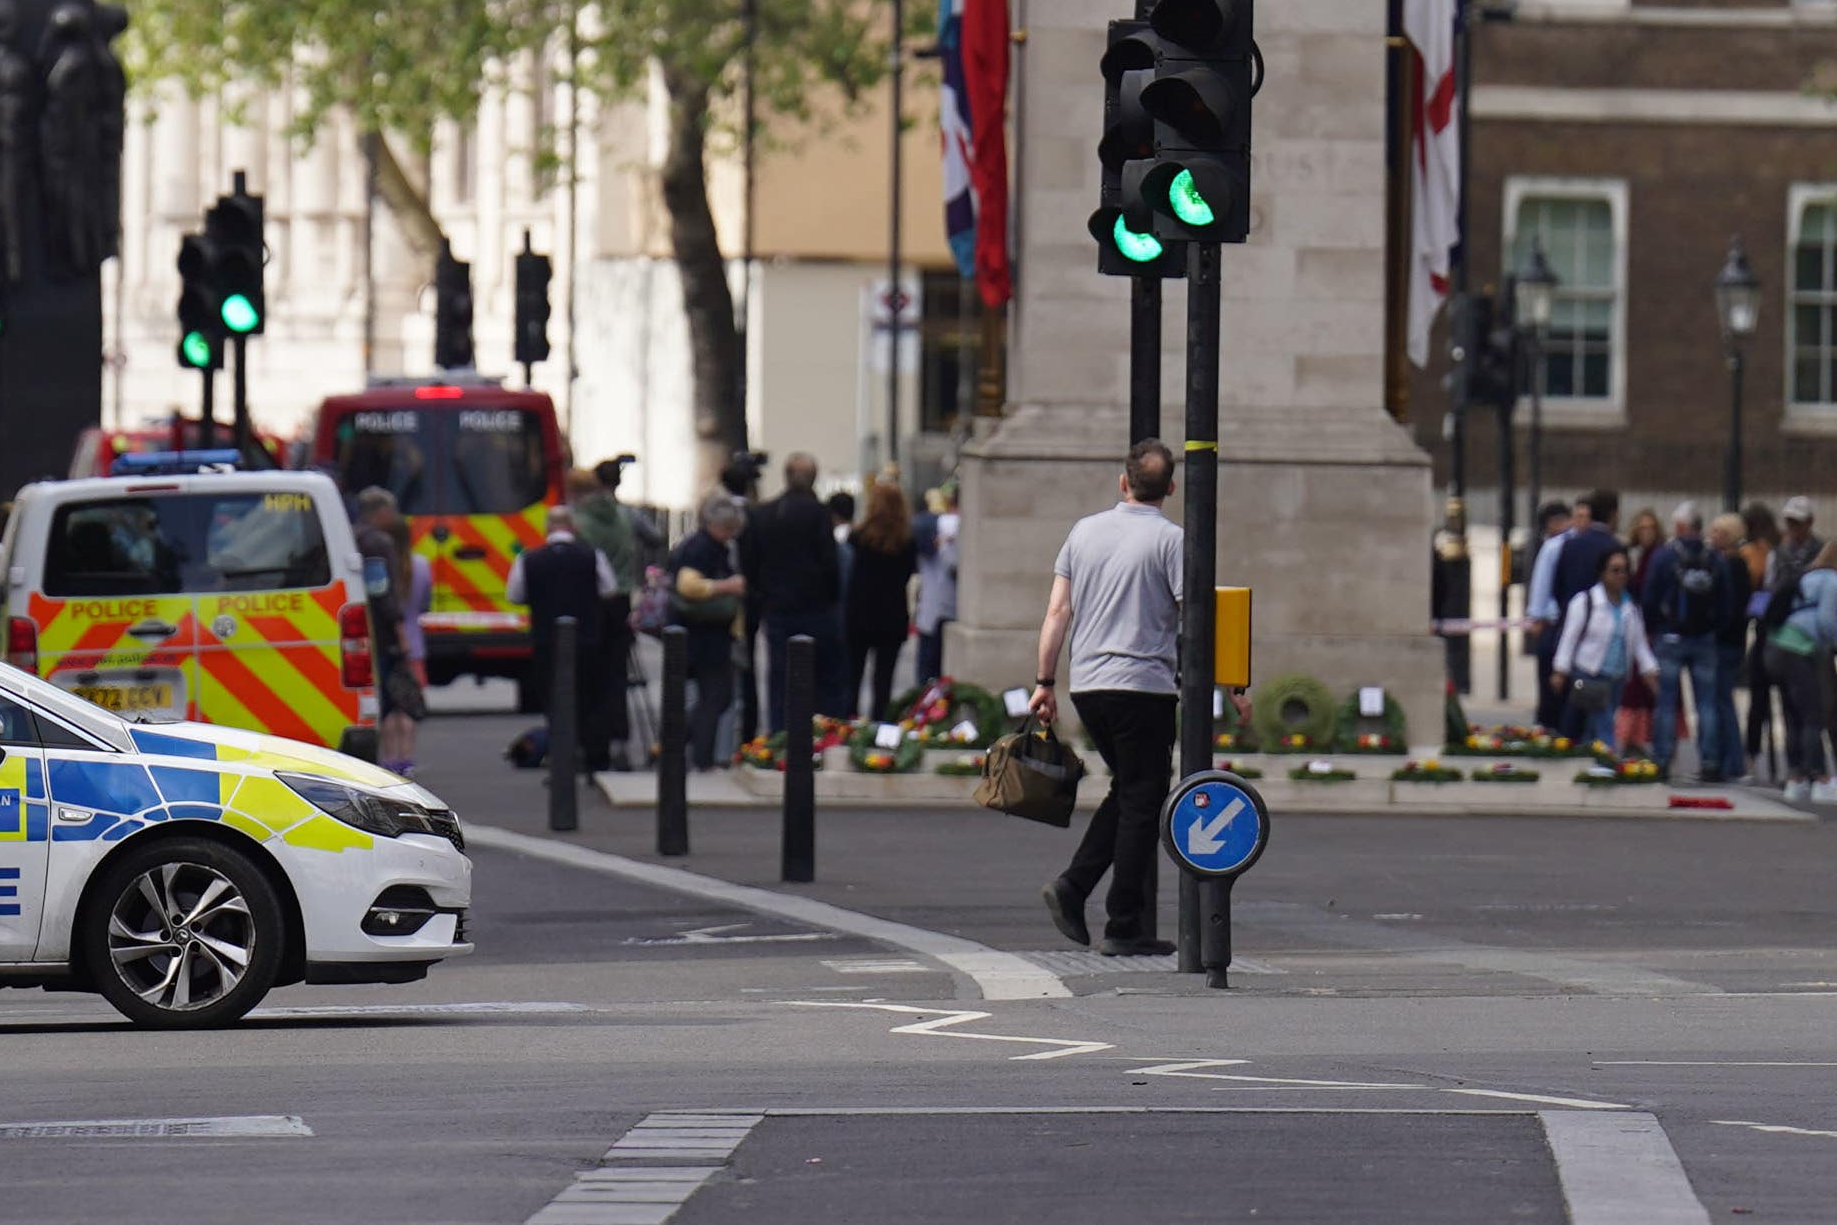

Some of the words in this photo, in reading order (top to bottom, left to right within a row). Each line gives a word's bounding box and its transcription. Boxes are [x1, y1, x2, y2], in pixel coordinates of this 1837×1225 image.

[355, 411, 418, 432] POLICE
[460, 409, 524, 431] POLICE
[71, 599, 158, 620] POLICE
[218, 593, 305, 615] POLICE
